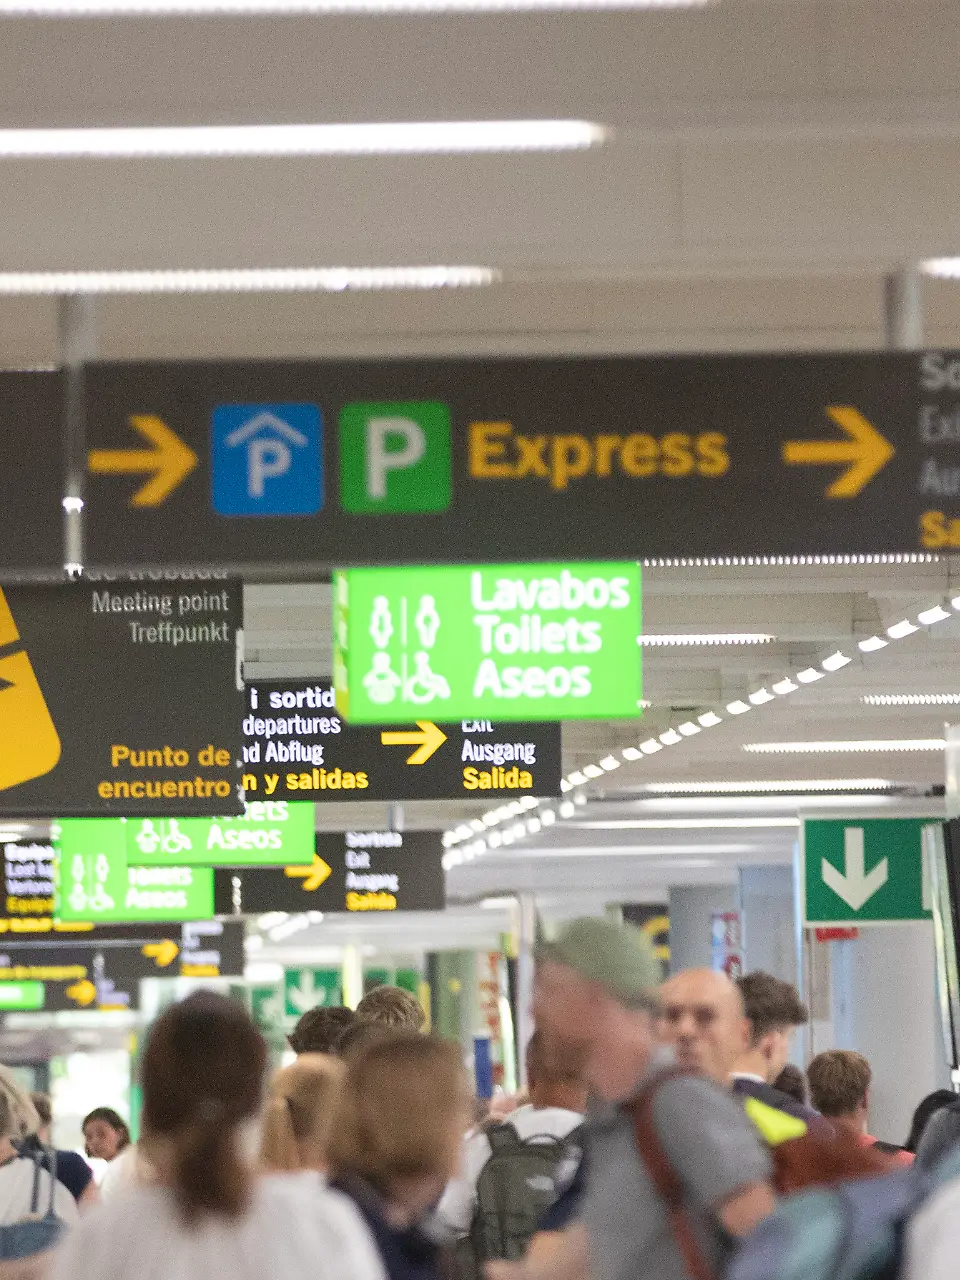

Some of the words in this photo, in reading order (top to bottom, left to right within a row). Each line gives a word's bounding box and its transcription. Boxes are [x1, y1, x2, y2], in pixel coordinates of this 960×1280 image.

[247, 438, 292, 499] P
[366, 416, 427, 500] P
[469, 421, 731, 491] Express
[92, 590, 173, 616] Meeting
[178, 591, 230, 615] point
[470, 569, 631, 611] Lavabos
[129, 621, 230, 646] Treffpunkt
[473, 613, 603, 654] Toilets
[472, 658, 592, 698] Aseos
[250, 687, 258, 709] i
[242, 713, 342, 739] departures
[110, 744, 190, 768] Punto
[197, 744, 231, 768] de
[265, 740, 324, 765] Abflug
[461, 739, 536, 765] Ausgang
[97, 776, 232, 799] encuentro
[264, 774, 280, 795] y
[286, 767, 369, 790] salidas
[463, 766, 533, 790] Salida
[206, 824, 283, 850] Aseos
